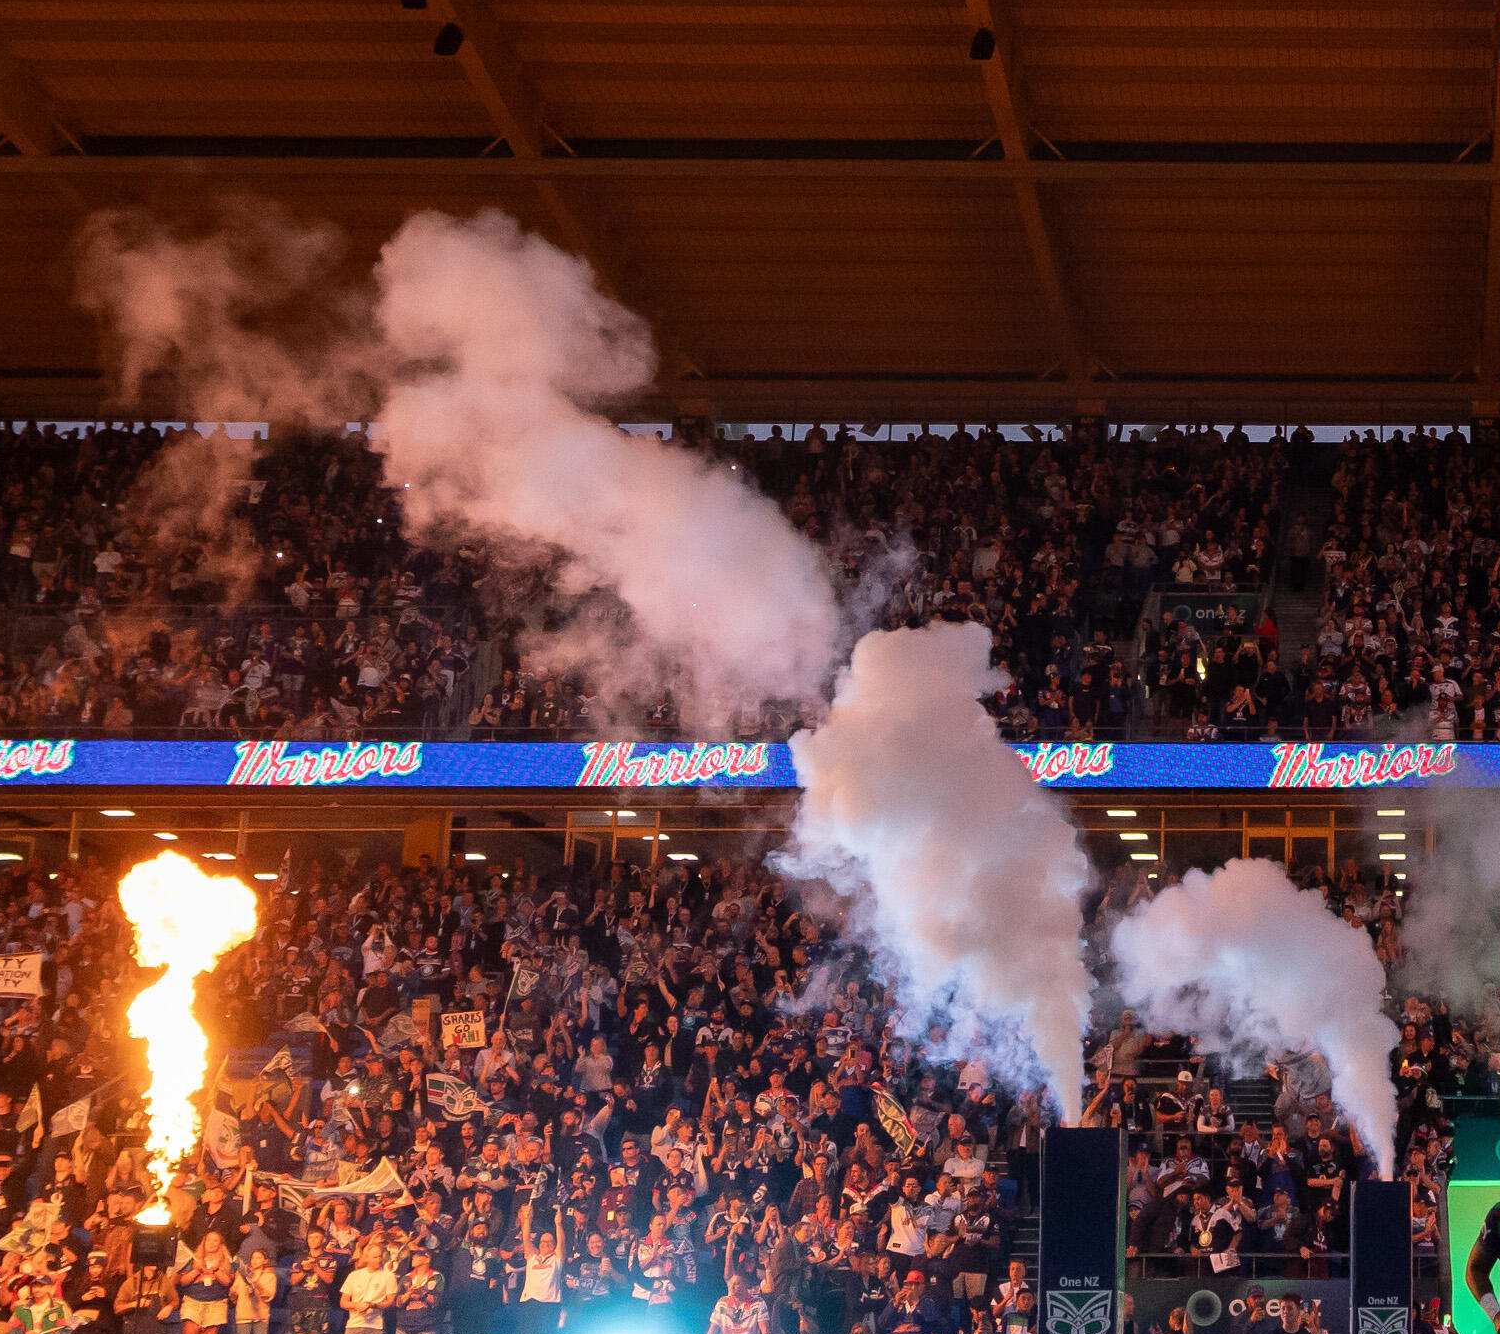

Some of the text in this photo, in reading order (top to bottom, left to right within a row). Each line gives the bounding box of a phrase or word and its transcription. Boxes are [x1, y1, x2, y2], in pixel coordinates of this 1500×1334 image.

[227, 740, 422, 785] Warriors
[576, 742, 768, 787] Warriors
[1268, 743, 1457, 787] Warriors
[443, 1012, 481, 1025] SHARKS
[455, 1024, 470, 1033] GO
[1060, 1276, 1100, 1287] One NZ
[1368, 1296, 1399, 1306] One NZ
